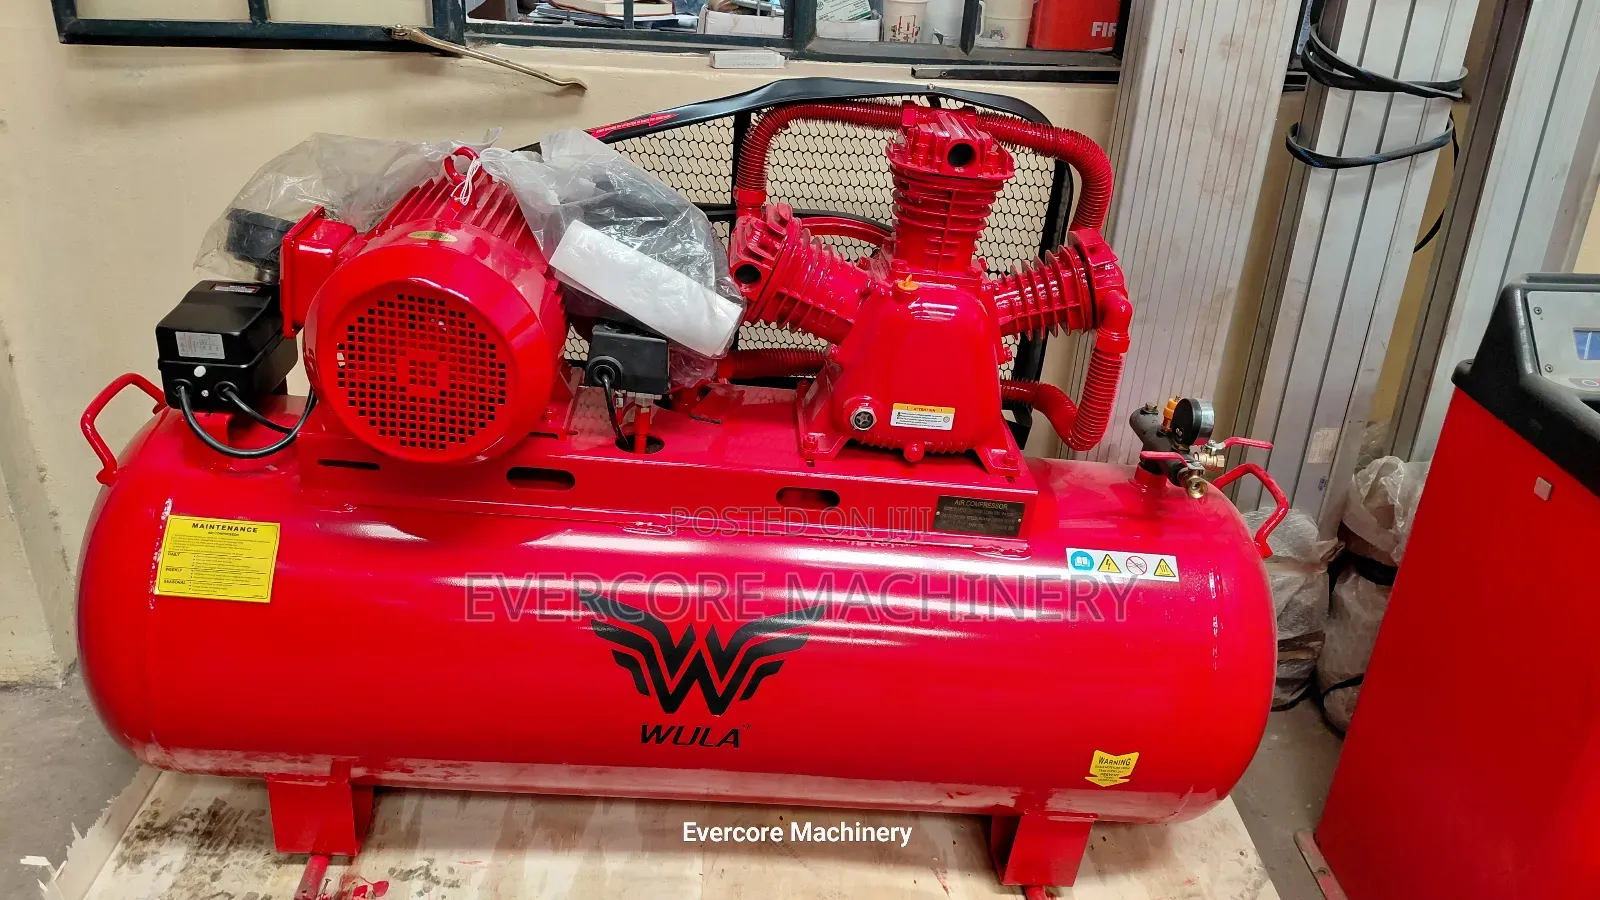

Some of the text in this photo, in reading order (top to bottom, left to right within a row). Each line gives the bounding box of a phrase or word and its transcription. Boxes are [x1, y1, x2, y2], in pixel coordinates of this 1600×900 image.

[966, 500, 1008, 510] COMPRESSOR
[192, 523, 258, 533] MAINTENANCE
[641, 724, 740, 748] WULA
[1098, 756, 1131, 766] WARNING
